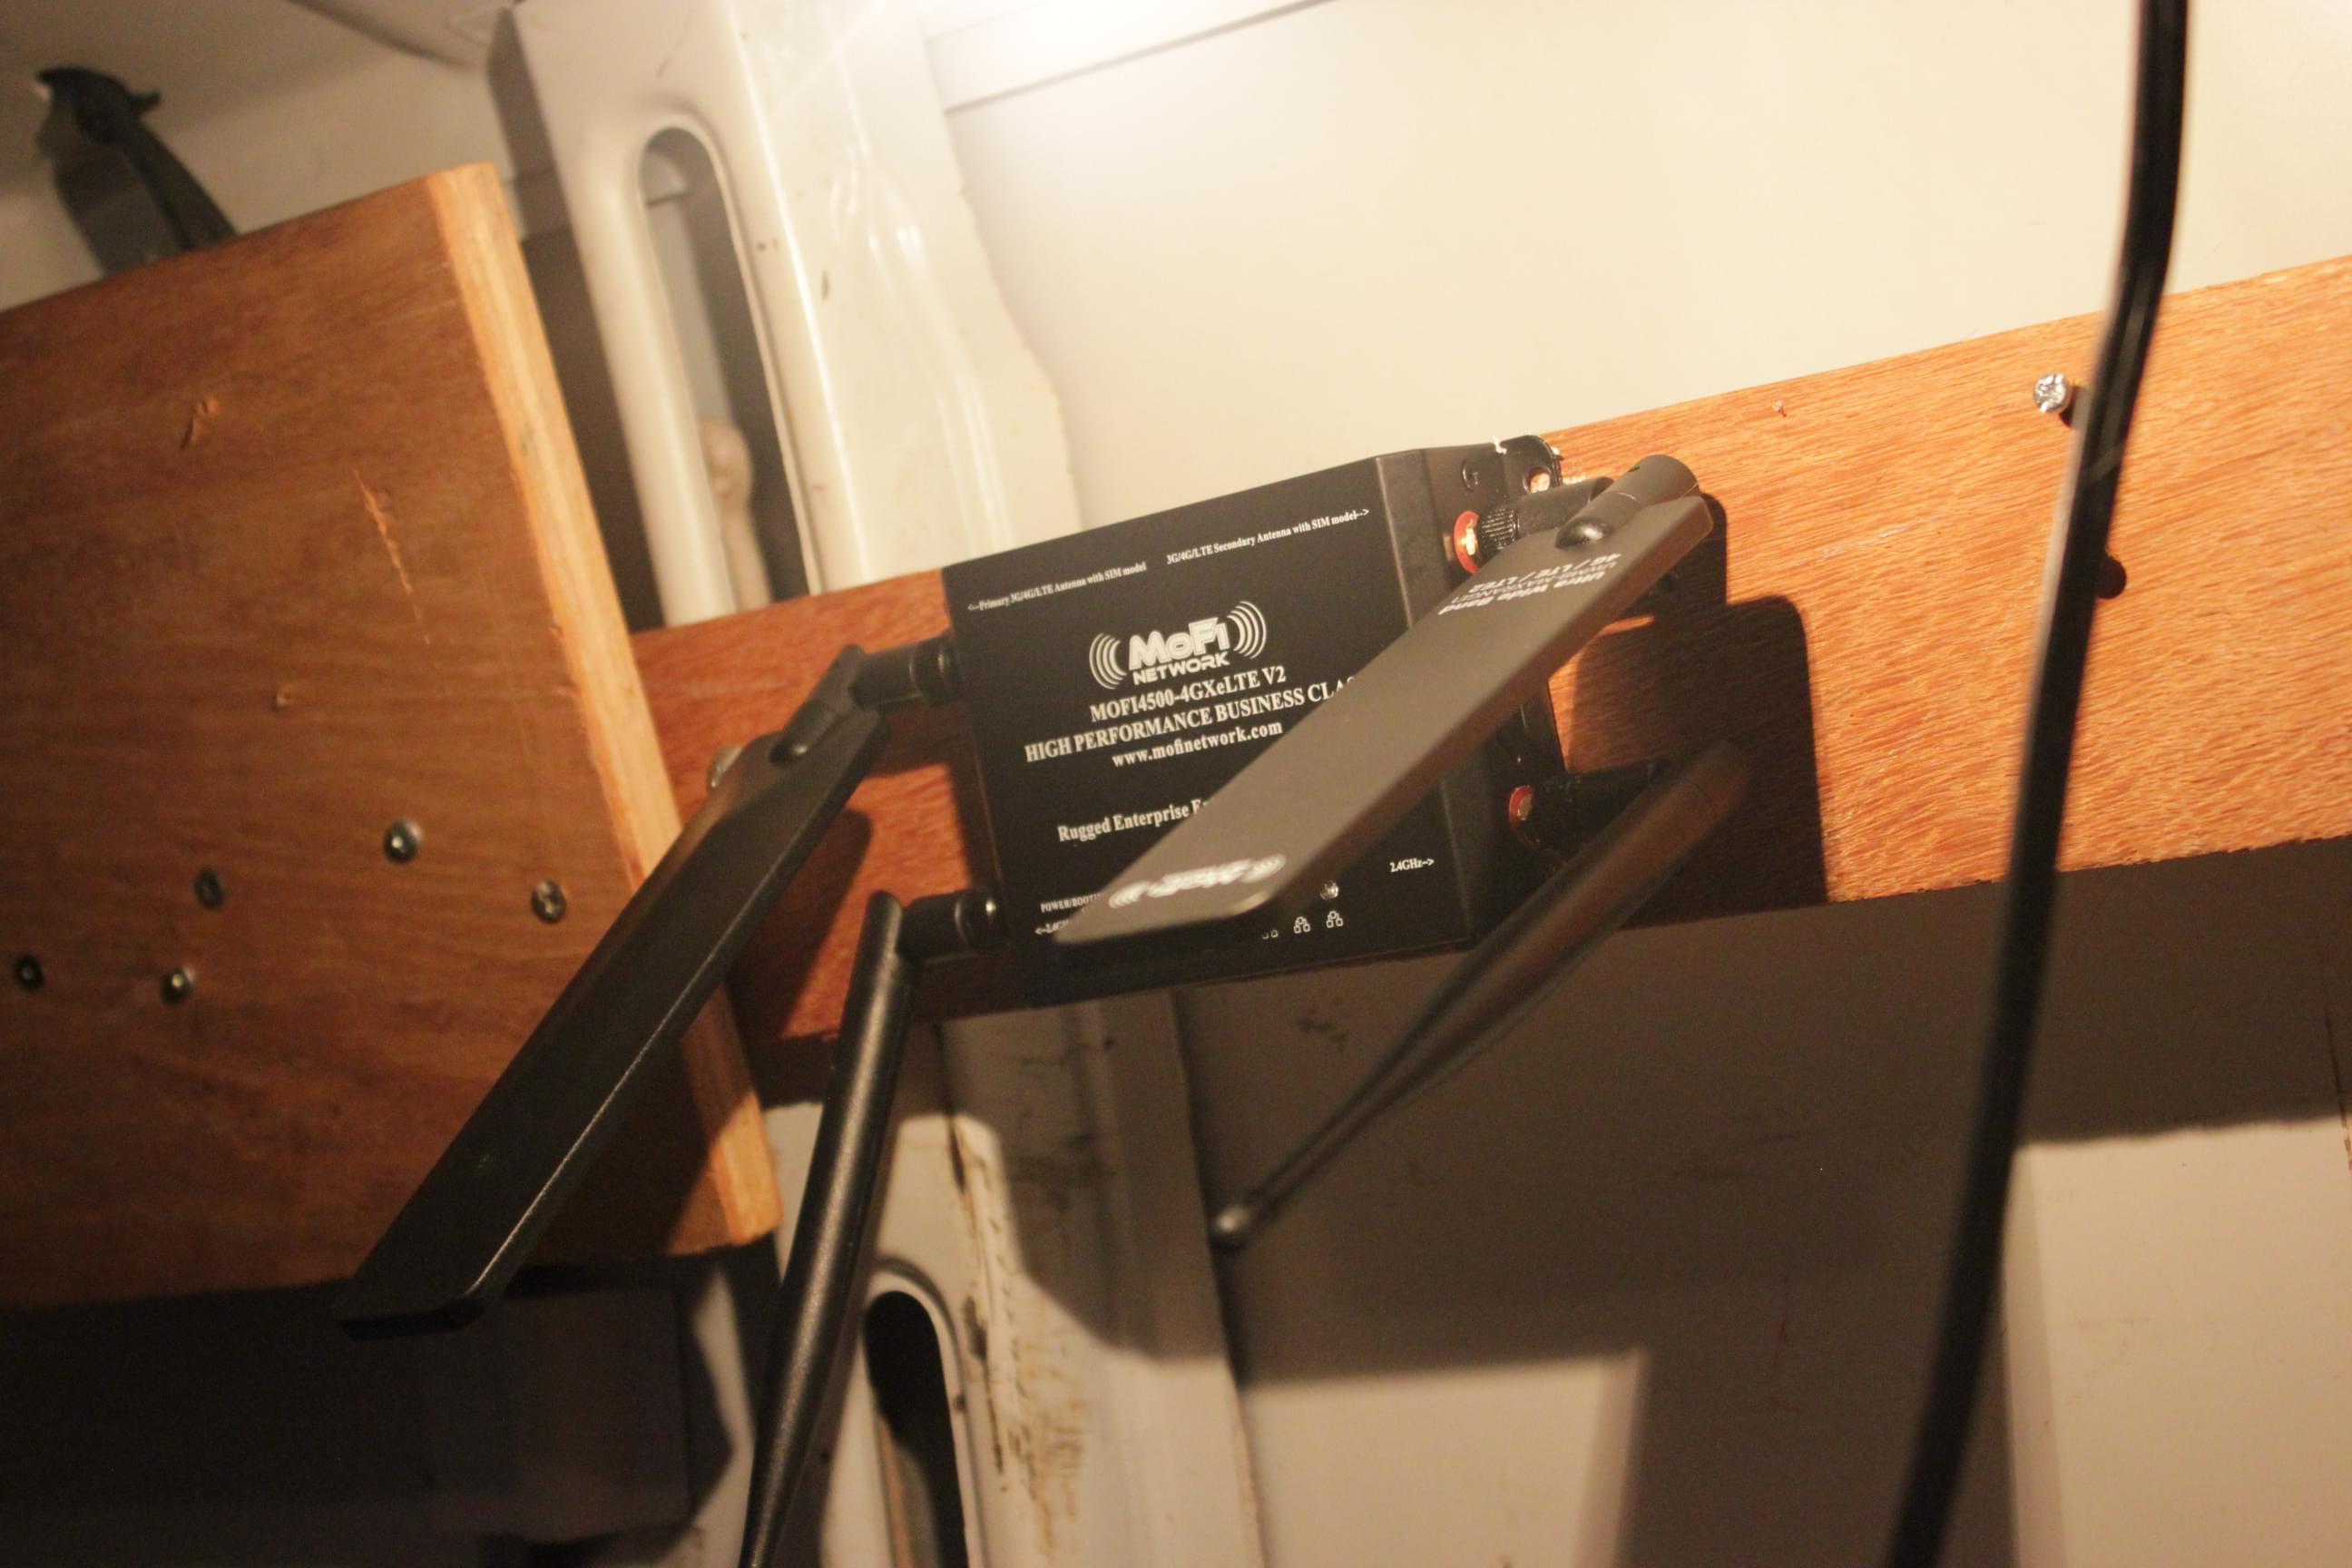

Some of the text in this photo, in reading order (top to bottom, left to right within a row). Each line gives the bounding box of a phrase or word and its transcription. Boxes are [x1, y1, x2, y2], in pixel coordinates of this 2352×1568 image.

[1167, 544, 1213, 564] 3G/4G/LTE
[1213, 536, 1256, 554] Secondary
[1257, 528, 1291, 544] Antenna
[1292, 521, 1311, 534] with
[1312, 516, 1330, 530] SIM
[1010, 583, 1054, 603] 3G/4G/LTE
[1054, 578, 1086, 593] Antenna
[1086, 572, 1104, 584] with
[1104, 567, 1122, 580] SIM
[1122, 561, 1147, 575] model
[1132, 651, 1230, 685] NETWORK
[1090, 665, 1287, 722] MOFI4500-4GXeLTE V2
[1024, 676, 1355, 762] HIGH PERFORMANCE BUSINESS CLA
[1112, 721, 1283, 768] www.mofinetwork.com
[1057, 818, 1112, 842] Rugged
[1112, 804, 1190, 831] Enterprise
